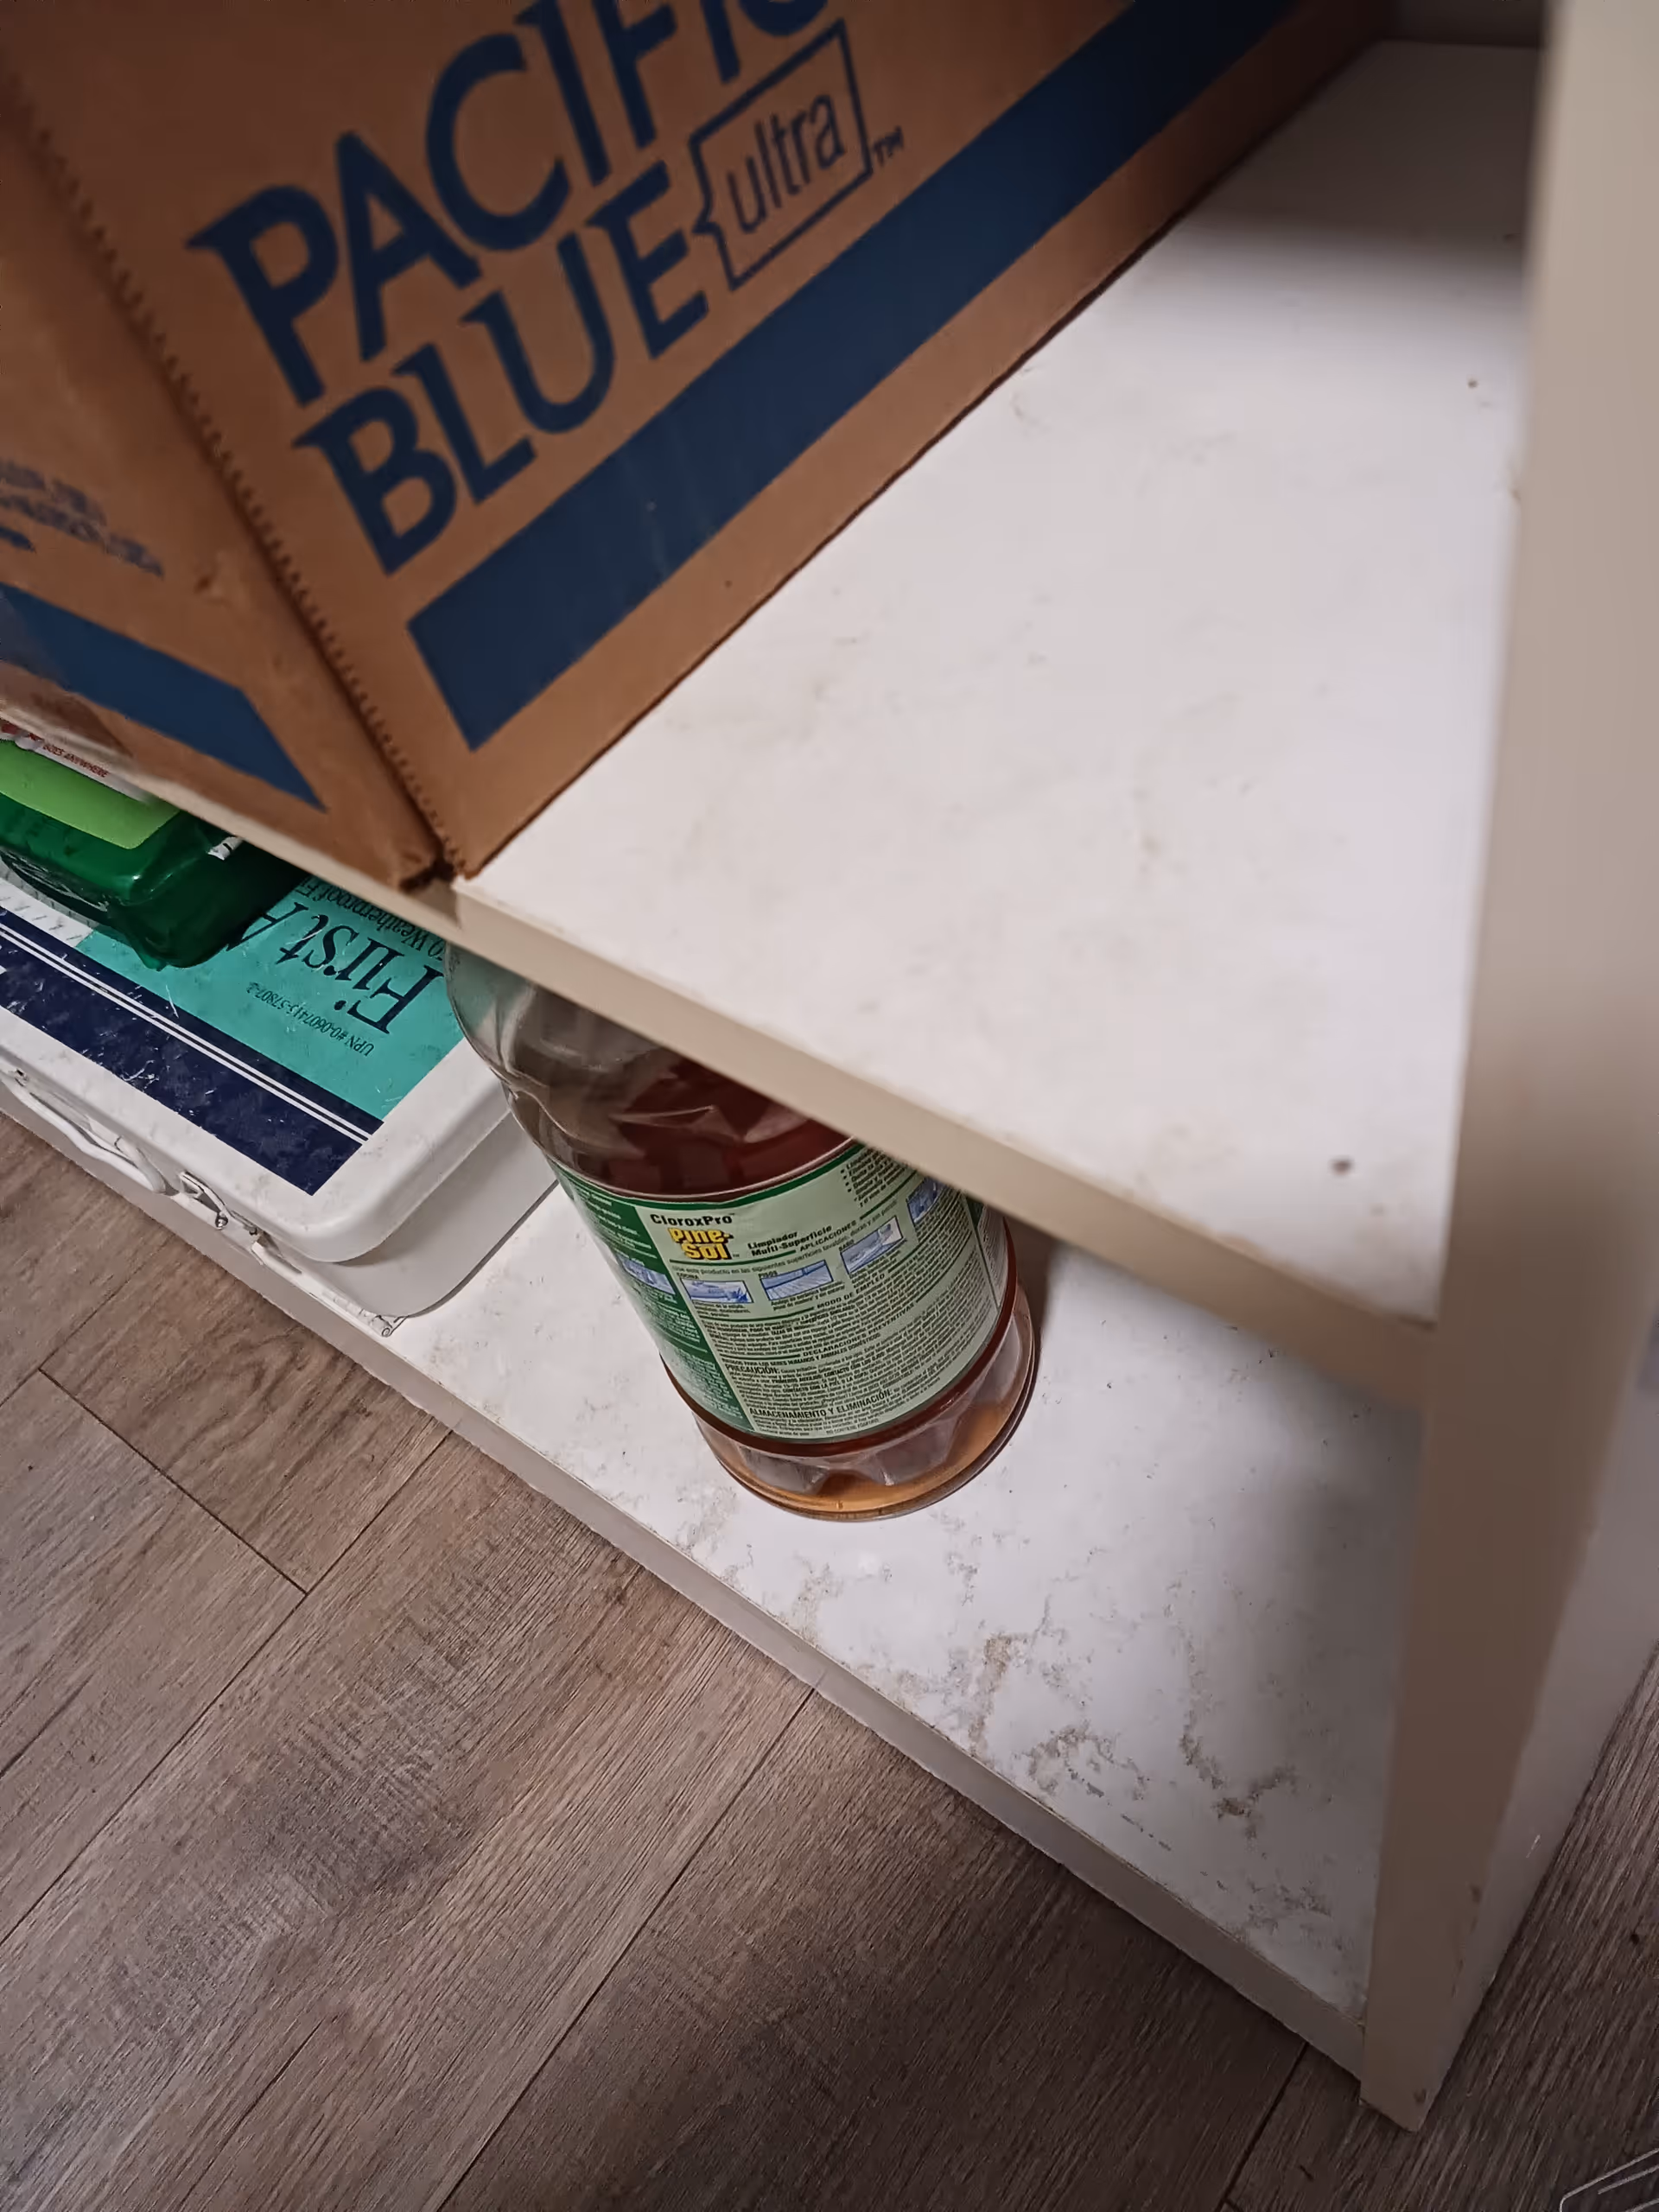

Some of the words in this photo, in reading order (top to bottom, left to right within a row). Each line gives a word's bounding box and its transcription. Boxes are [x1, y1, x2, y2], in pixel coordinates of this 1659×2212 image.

[727, 94, 846, 234] ultra
[185, 0, 827, 406] PACIFI
[292, 159, 709, 575] BLUE
[276, 913, 444, 1035] First
[346, 1039, 375, 1057] UPN
[668, 1227, 734, 1244] Pine-
[681, 1242, 734, 1261] Sol
[747, 1230, 798, 1250] Limpiador
[750, 1224, 832, 1257] Multi-Superficie
[799, 1219, 857, 1252] APLICACIONES
[817, 1297, 842, 1309] MODO
[843, 1292, 855, 1300] DE
[855, 1273, 886, 1294] EMPLEO
[803, 1333, 866, 1357] DECLARACIONES
[868, 1301, 915, 1335] PREVENTIVAS
[725, 1363, 781, 1374] PRECAUCIÓN:
[749, 1408, 827, 1418] ALMACENAMIENTO
[836, 1389, 893, 1413] ELIMINACIÓN:
